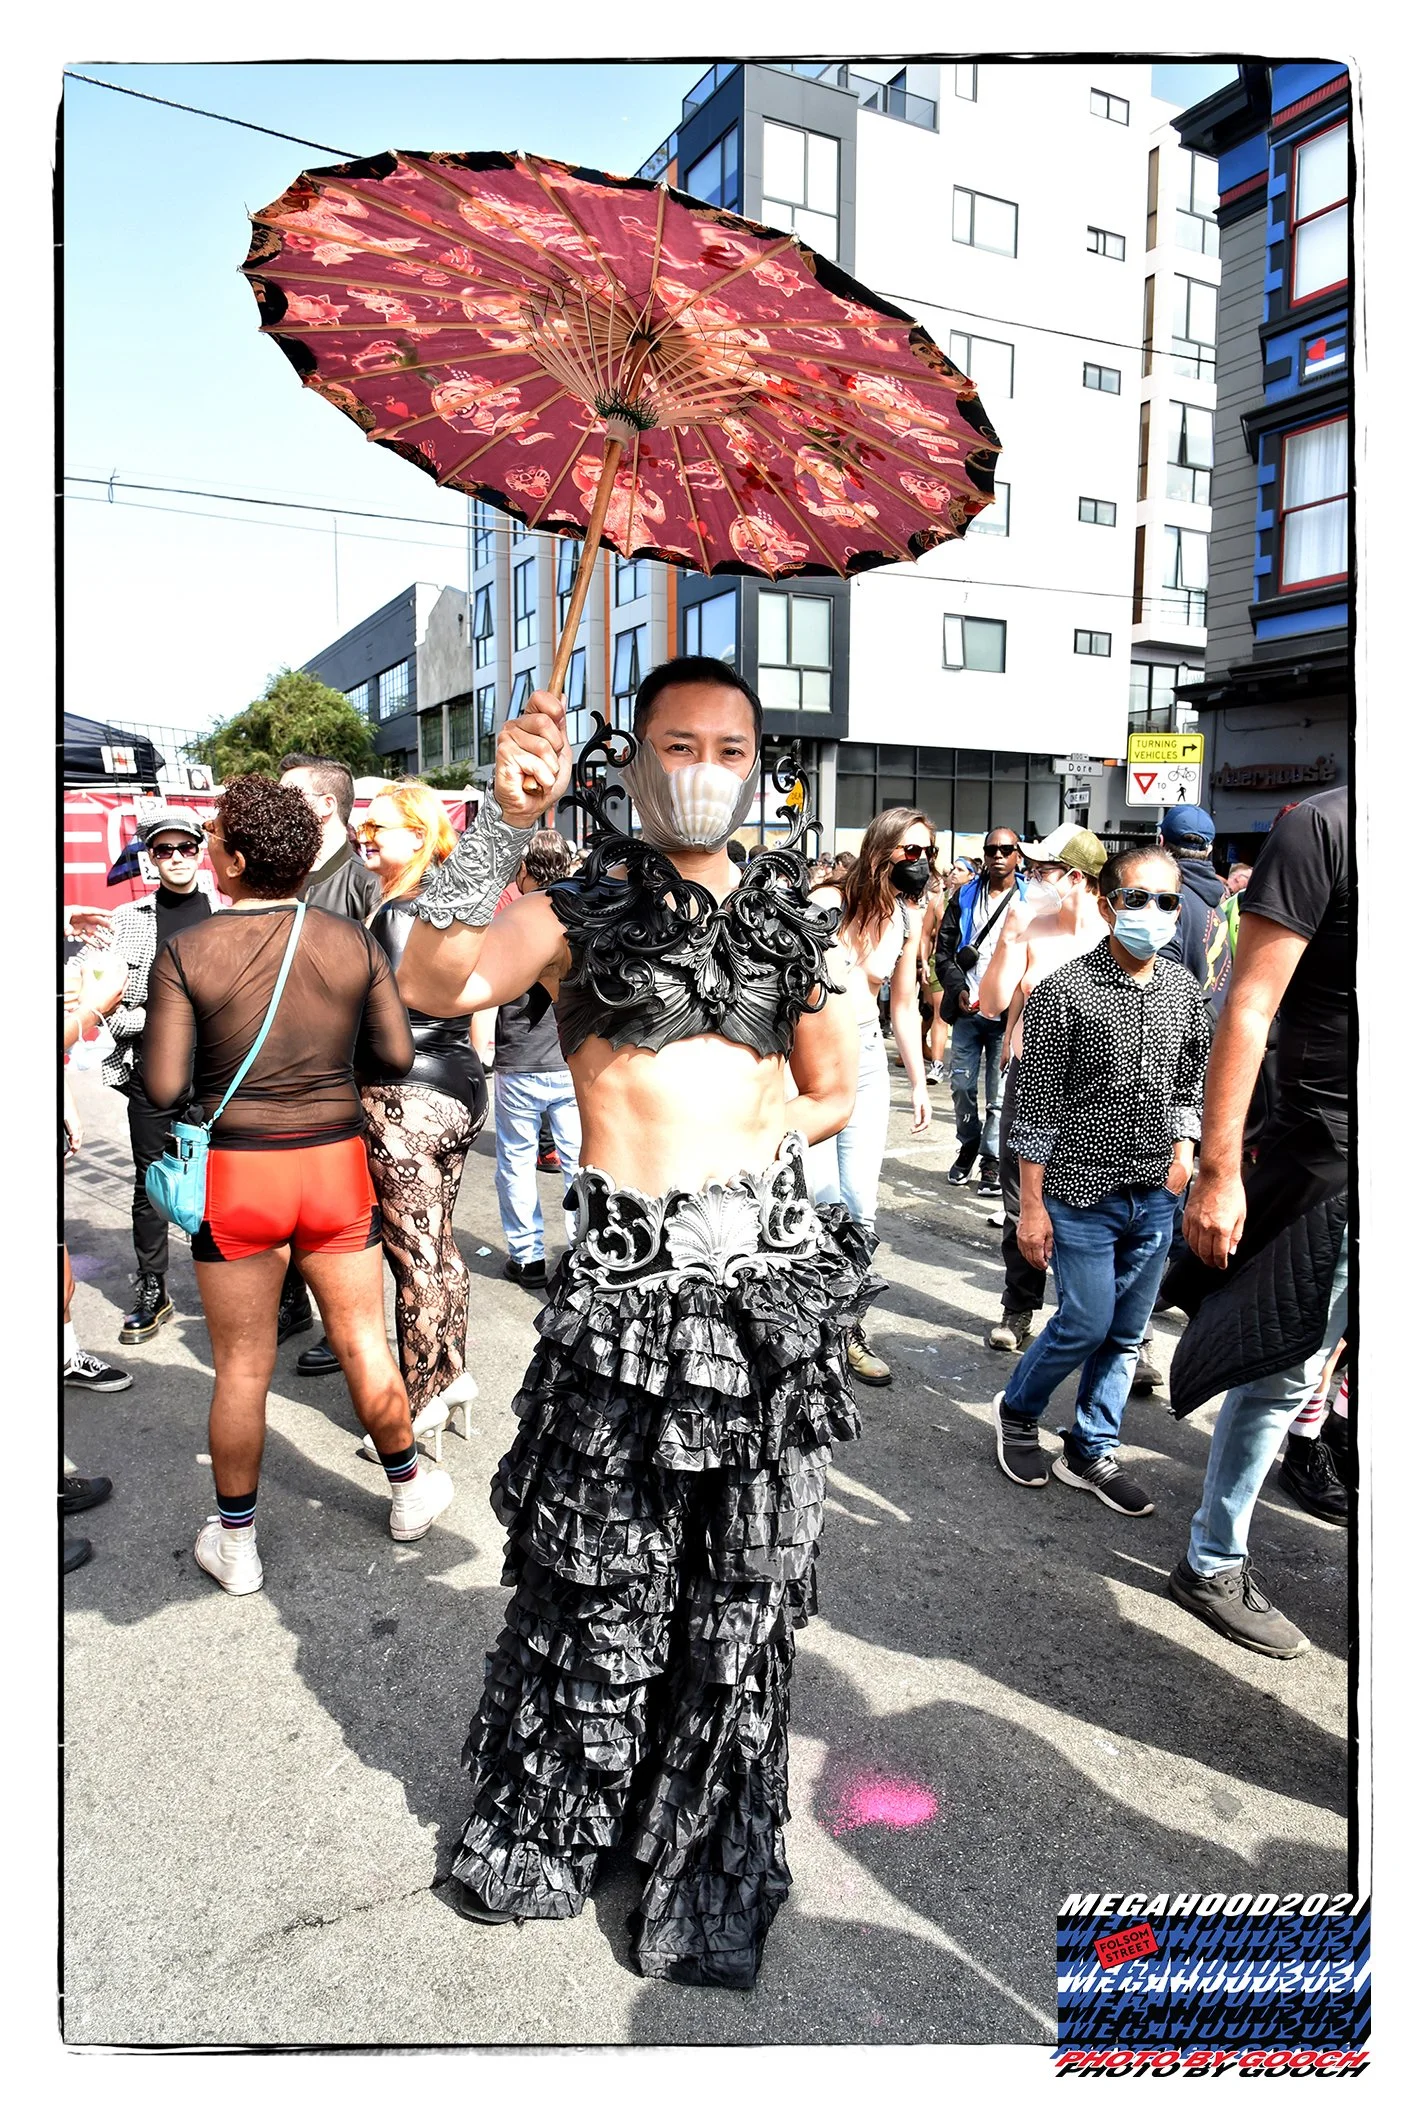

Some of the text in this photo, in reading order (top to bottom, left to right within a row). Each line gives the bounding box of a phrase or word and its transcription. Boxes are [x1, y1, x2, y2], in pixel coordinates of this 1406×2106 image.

[1136, 739, 1178, 749] TURNING
[1134, 750, 1179, 760] VEHICLES
[1068, 763, 1093, 773] Dore
[1157, 782, 1168, 790] TO
